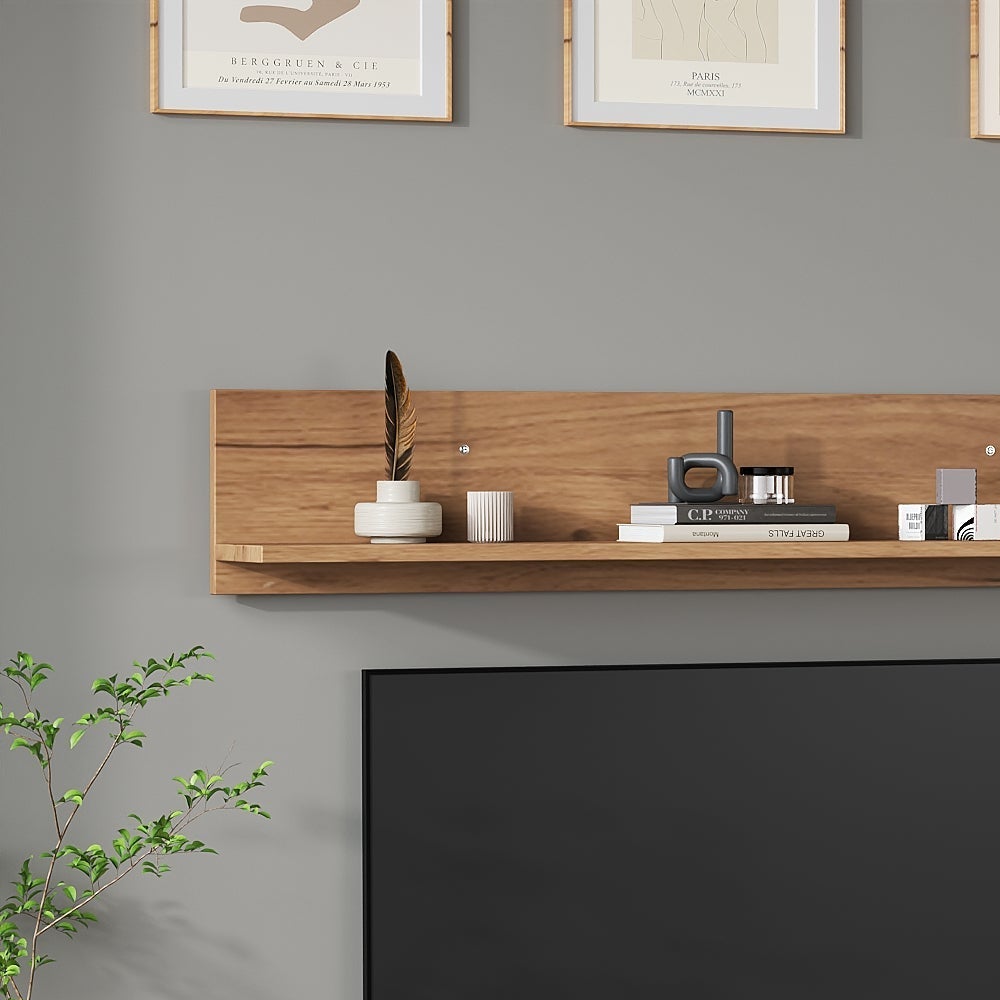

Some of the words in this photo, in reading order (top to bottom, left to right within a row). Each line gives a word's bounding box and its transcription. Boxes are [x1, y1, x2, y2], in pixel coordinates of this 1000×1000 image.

[231, 57, 326, 68] BERGGRUEN
[335, 61, 343, 69] &
[353, 61, 378, 70] CIE
[692, 72, 720, 81] PARIS
[231, 76, 264, 84] Vendredi
[314, 78, 342, 86] Samedi
[353, 80, 372, 88] Mars
[687, 88, 725, 96] MCMXXI
[687, 508, 713, 521] C.P.
[768, 530, 794, 538] FALLS
[795, 530, 825, 538] GREAT
